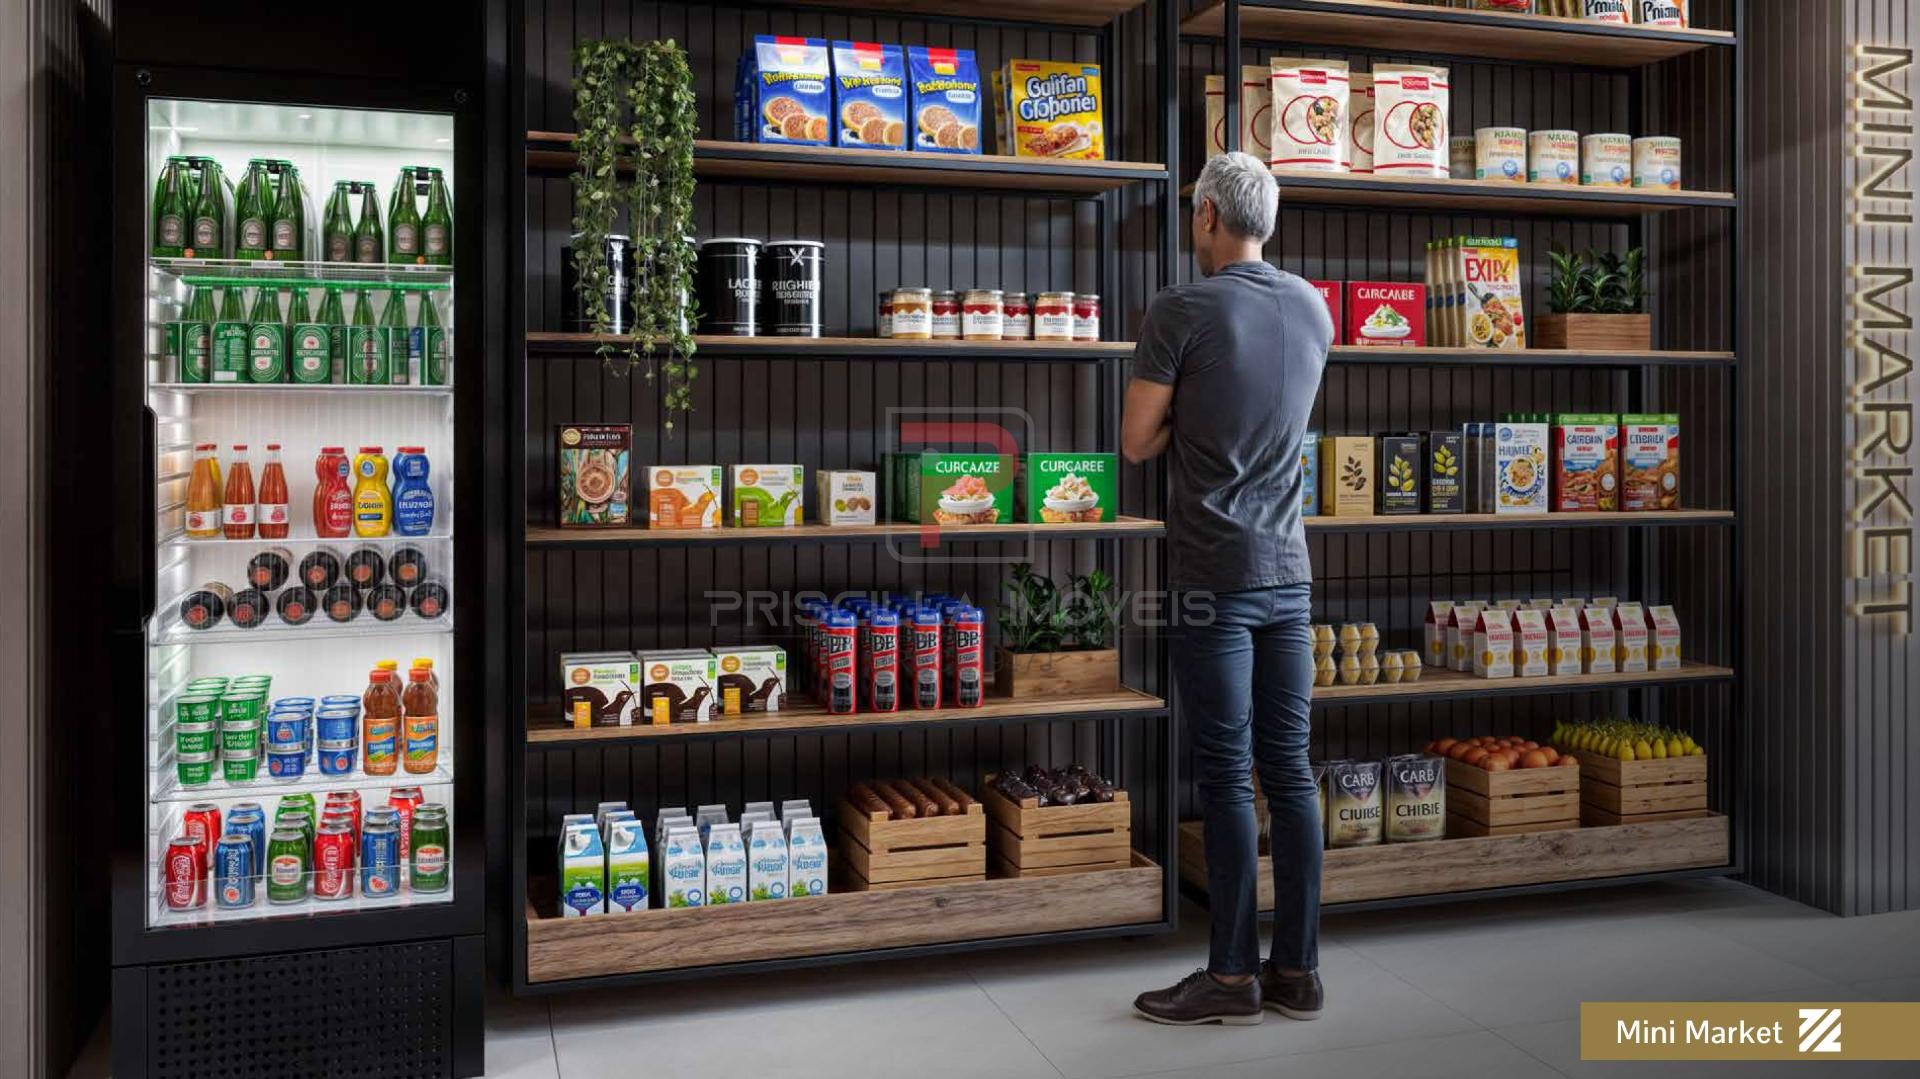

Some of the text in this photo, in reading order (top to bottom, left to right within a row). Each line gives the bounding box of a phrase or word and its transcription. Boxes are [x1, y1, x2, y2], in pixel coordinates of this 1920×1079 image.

[1860, 45, 1915, 634] MINI MARKET
[1342, 772, 1375, 788] CARB
[1400, 769, 1435, 784] CARB
